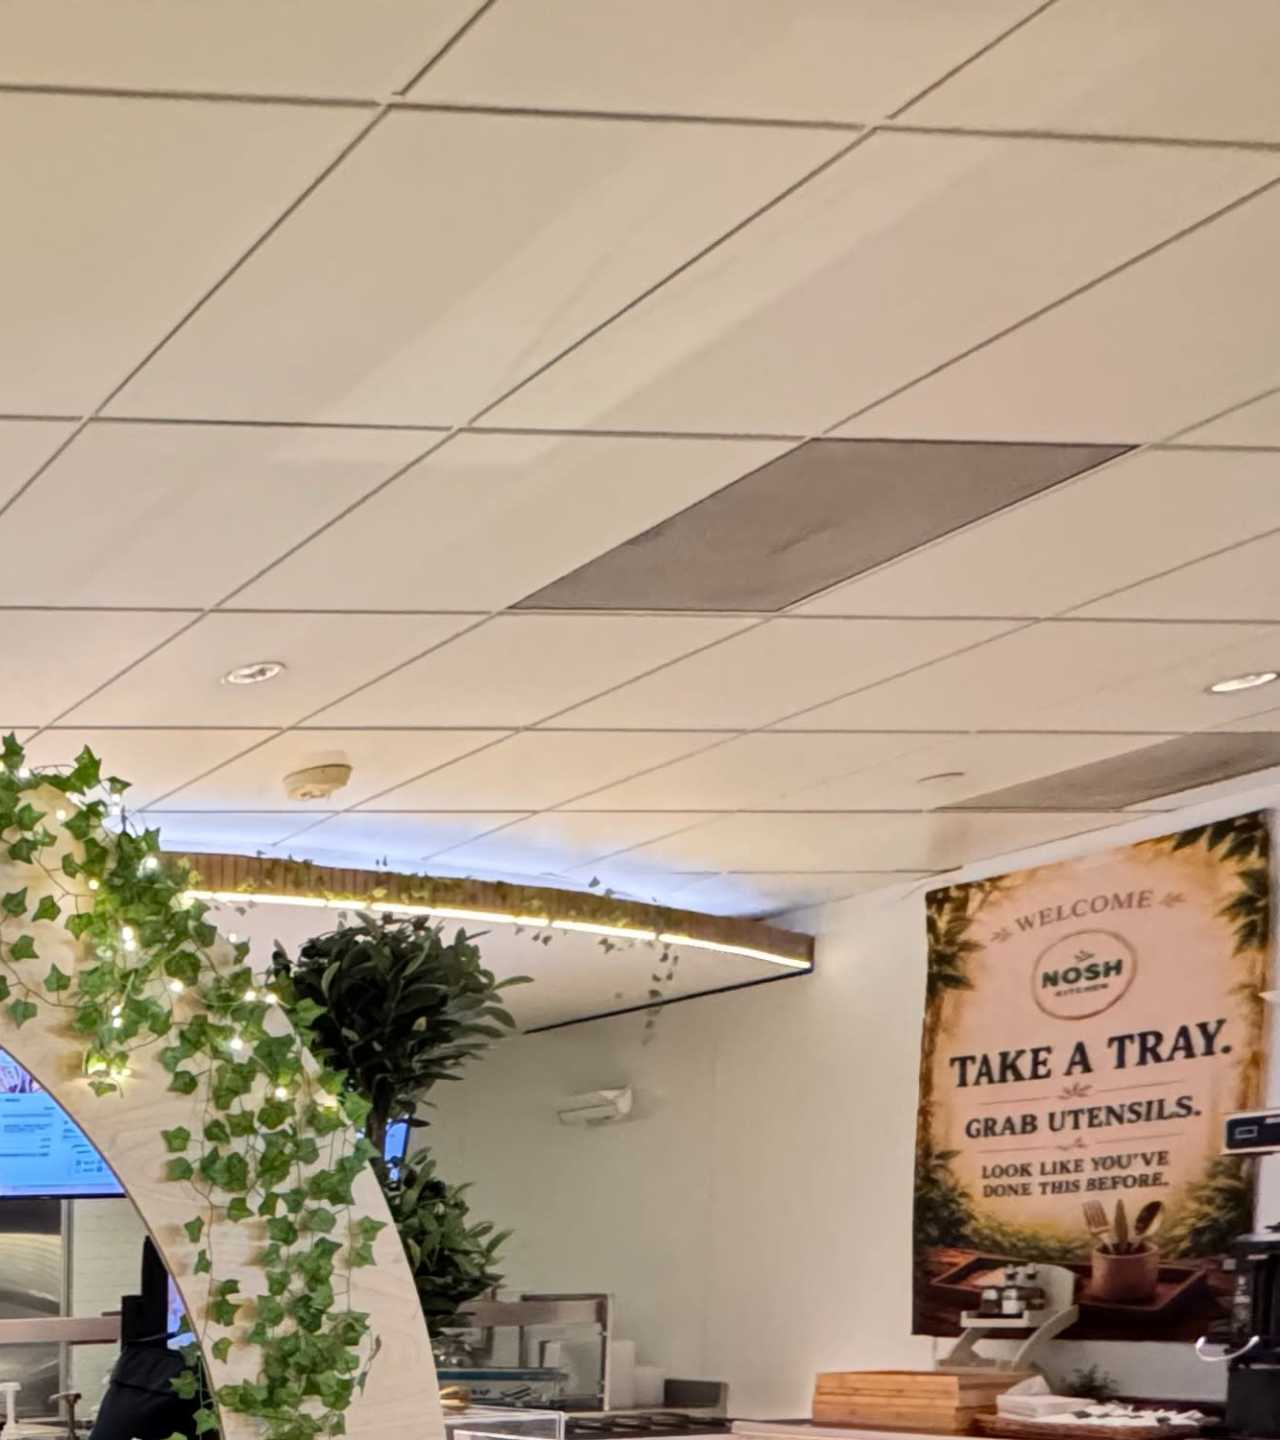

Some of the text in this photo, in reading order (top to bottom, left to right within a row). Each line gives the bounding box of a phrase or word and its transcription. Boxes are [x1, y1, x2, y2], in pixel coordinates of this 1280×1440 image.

[1015, 889, 1154, 932] WELCOME
[1042, 959, 1123, 989] NOSH
[950, 1019, 1232, 1087] TAKE A TRAY.
[965, 1095, 1202, 1139] GRAB UTENSILS.
[982, 1150, 1169, 1179] LOOK LIKE YOU'VE
[983, 1171, 1169, 1198] DONE THIS BEFORE.
